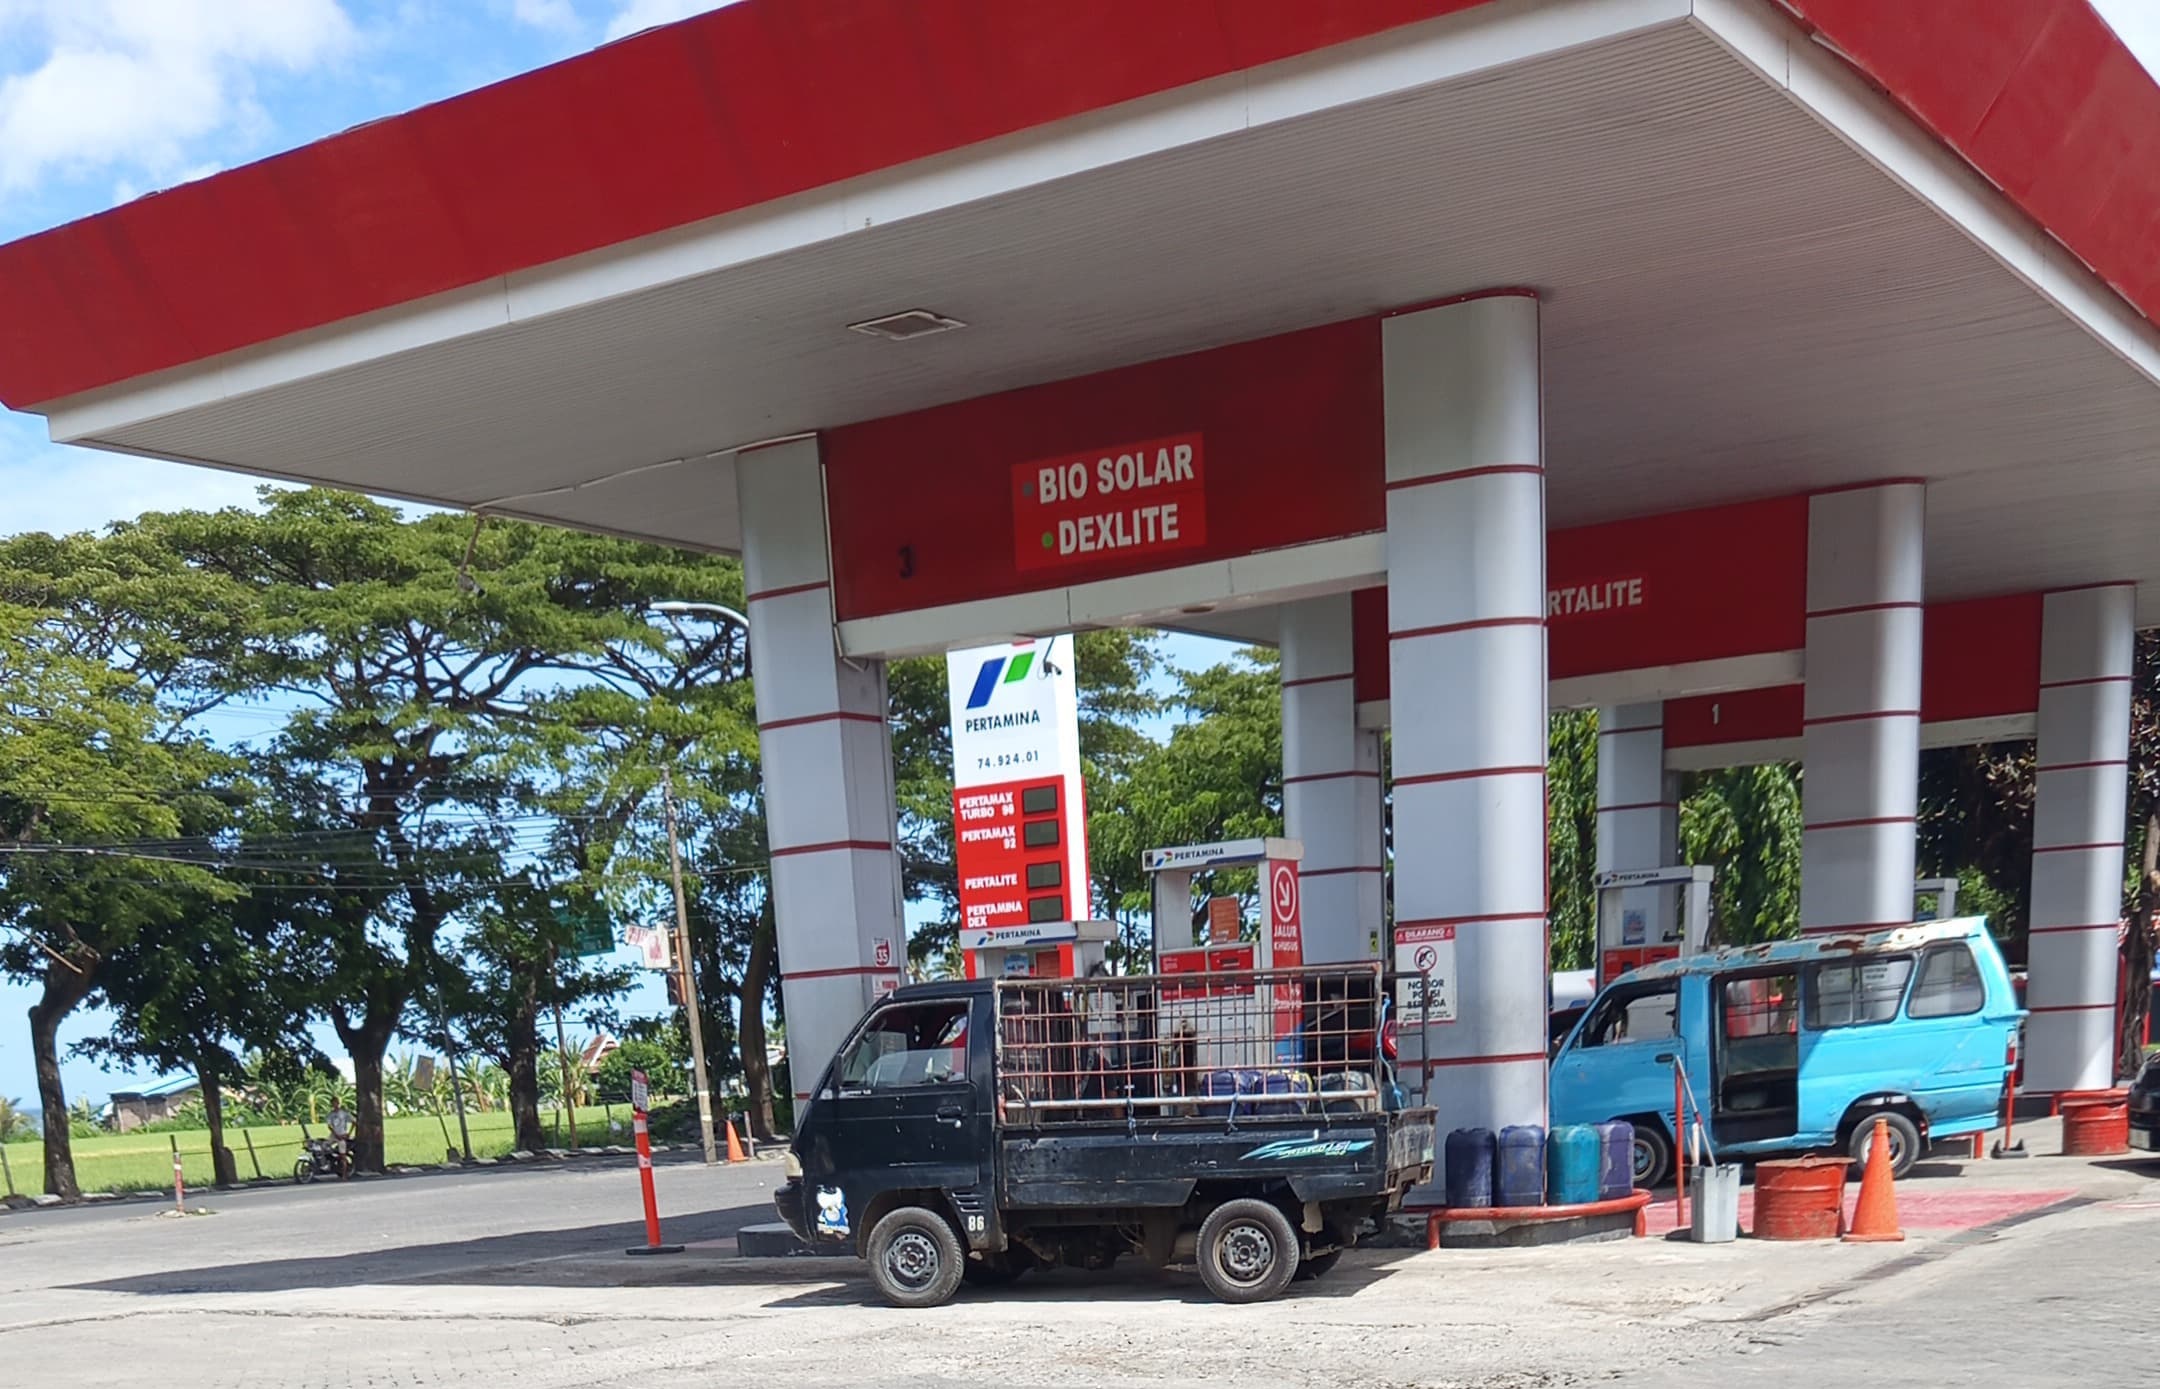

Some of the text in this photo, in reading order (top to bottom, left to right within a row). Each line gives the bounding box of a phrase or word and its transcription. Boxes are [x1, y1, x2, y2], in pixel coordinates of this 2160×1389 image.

[1039, 444, 1194, 504] BIO SOLAR
[1058, 503, 1179, 555] DEXLITE
[1549, 577, 1643, 616] RTALITE
[966, 709, 1041, 733] PERTAMINA
[1711, 703, 1720, 725] 1
[977, 750, 1039, 769] 74.924.01
[959, 791, 1014, 809] PERTAMAX
[960, 806, 995, 821] TURBO
[961, 825, 1016, 842] PERTAMAX
[1174, 848, 1225, 860] PERTAMINA
[964, 873, 1018, 890] PERTALITE
[966, 900, 1023, 917] PERTAMINA
[967, 915, 988, 928] DEX
[996, 929, 1041, 940] PERTAMINA
[1273, 924, 1297, 938] JALUR
[1404, 928, 1446, 938] DILARANG
[1407, 979, 1445, 990] NOOR
[968, 1215, 985, 1232] 86
